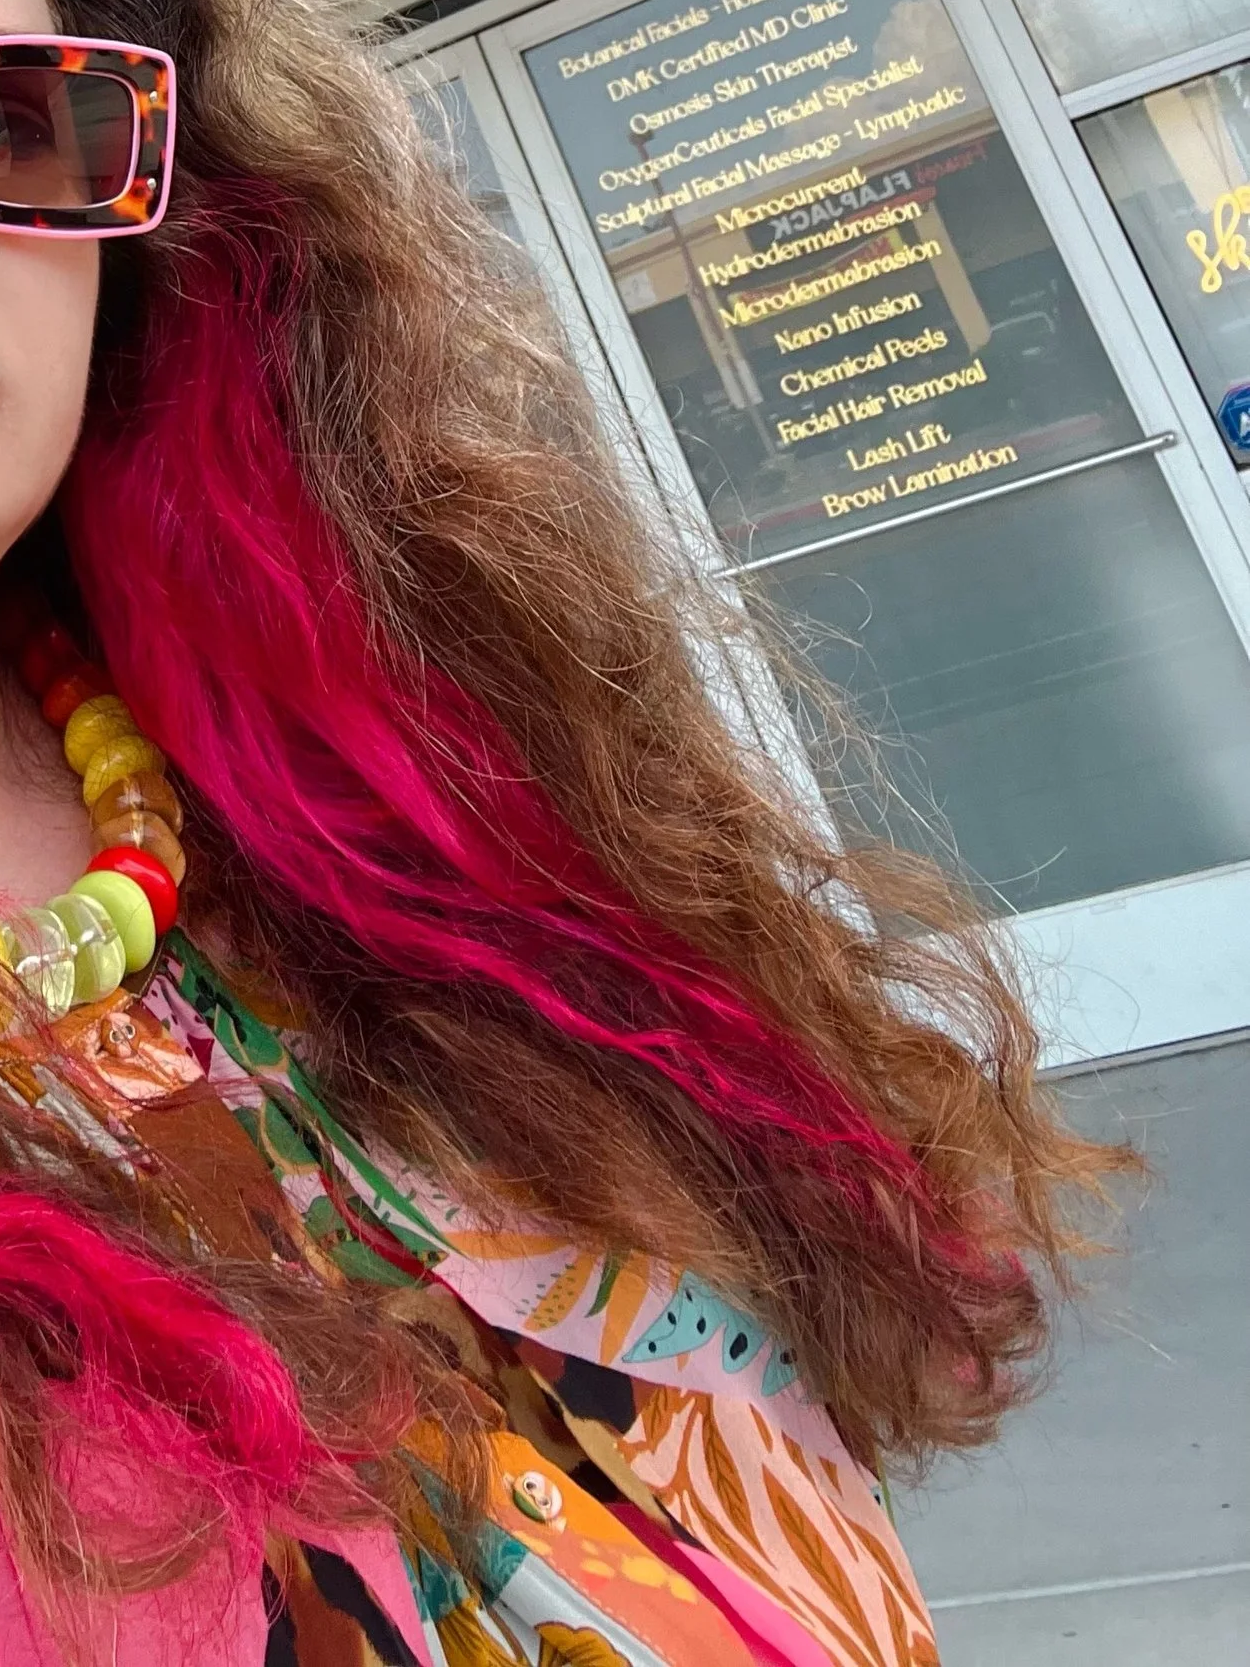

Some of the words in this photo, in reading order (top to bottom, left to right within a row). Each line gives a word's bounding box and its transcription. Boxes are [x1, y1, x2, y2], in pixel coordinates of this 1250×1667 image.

[558, 27, 648, 79] Botanical
[646, 6, 710, 44] Facials
[606, 66, 661, 103] DMK
[659, 29, 750, 80] Certified
[748, 15, 789, 48] MD
[629, 92, 714, 135] Osmosis
[713, 74, 758, 104] Skin
[755, 35, 858, 86] Therapist
[595, 182, 693, 235] Sculptural
[691, 163, 746, 202] Facial
[744, 132, 841, 184] Massage
[853, 86, 966, 142] Lymphatic
[599, 114, 767, 192] OxygenCeuticals
[766, 92, 824, 131] Facial
[822, 53, 924, 110] Specialist
[714, 165, 868, 234] Microcurrent
[1186, 184, 1250, 293] sk
[699, 200, 923, 287] Hydrodermabrasion
[718, 238, 943, 329] Microdermabrasion
[774, 321, 833, 355] Nano
[831, 291, 924, 336] Infusion
[780, 343, 887, 397] Chemical
[885, 326, 949, 363] Peels
[777, 405, 841, 446] Facial
[837, 394, 887, 425] Hair
[886, 358, 988, 409] Removal
[821, 483, 887, 518] Brow
[888, 445, 1019, 498] Lamination
[846, 437, 908, 471] Lash
[905, 423, 952, 454] Lift
